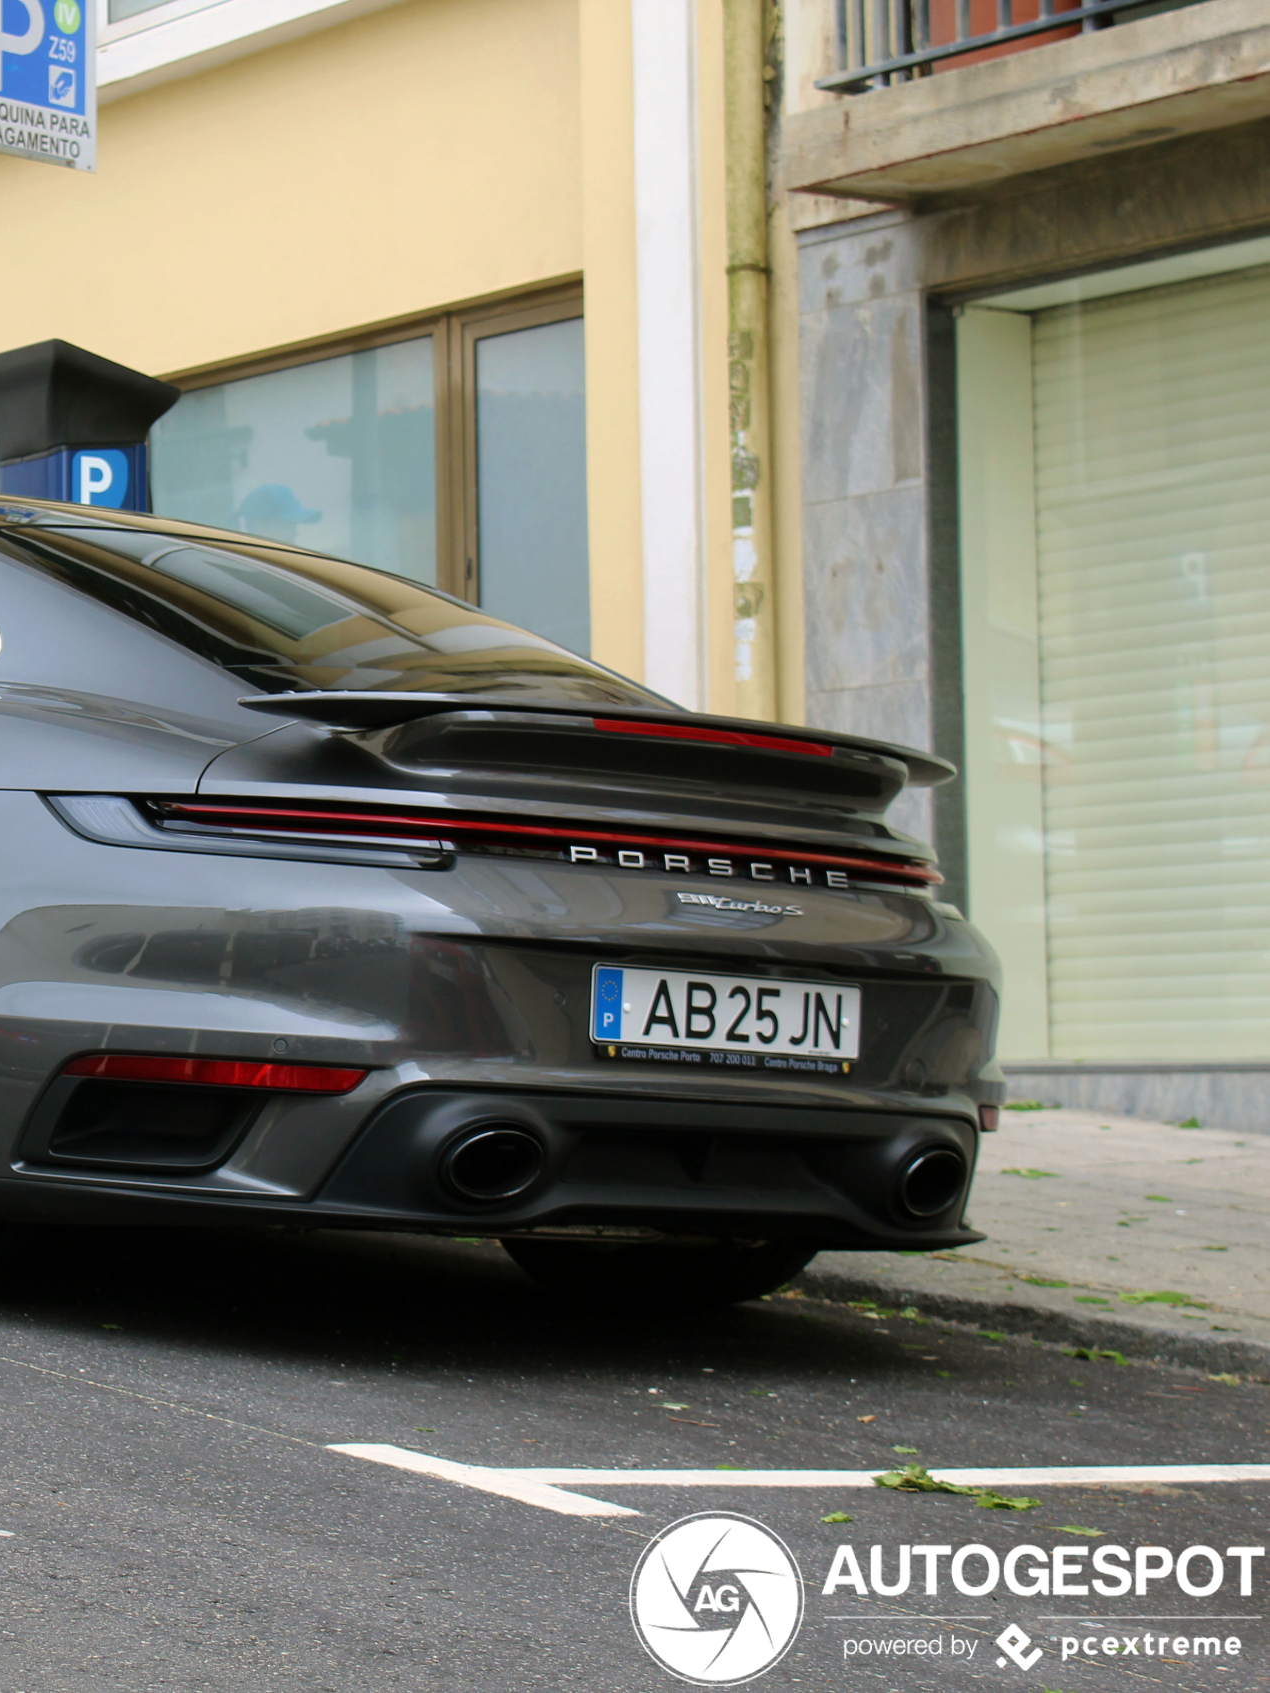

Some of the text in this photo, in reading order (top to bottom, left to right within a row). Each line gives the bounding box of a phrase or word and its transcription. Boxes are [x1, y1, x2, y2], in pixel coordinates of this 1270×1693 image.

[50, 114, 90, 139] PARA
[80, 455, 113, 505] P
[570, 845, 849, 888] PORSCHE
[603, 1012, 614, 1028] P
[621, 1047, 838, 1073] Centro Porsche Porto 707 200 011 Centro Porsche Braga
